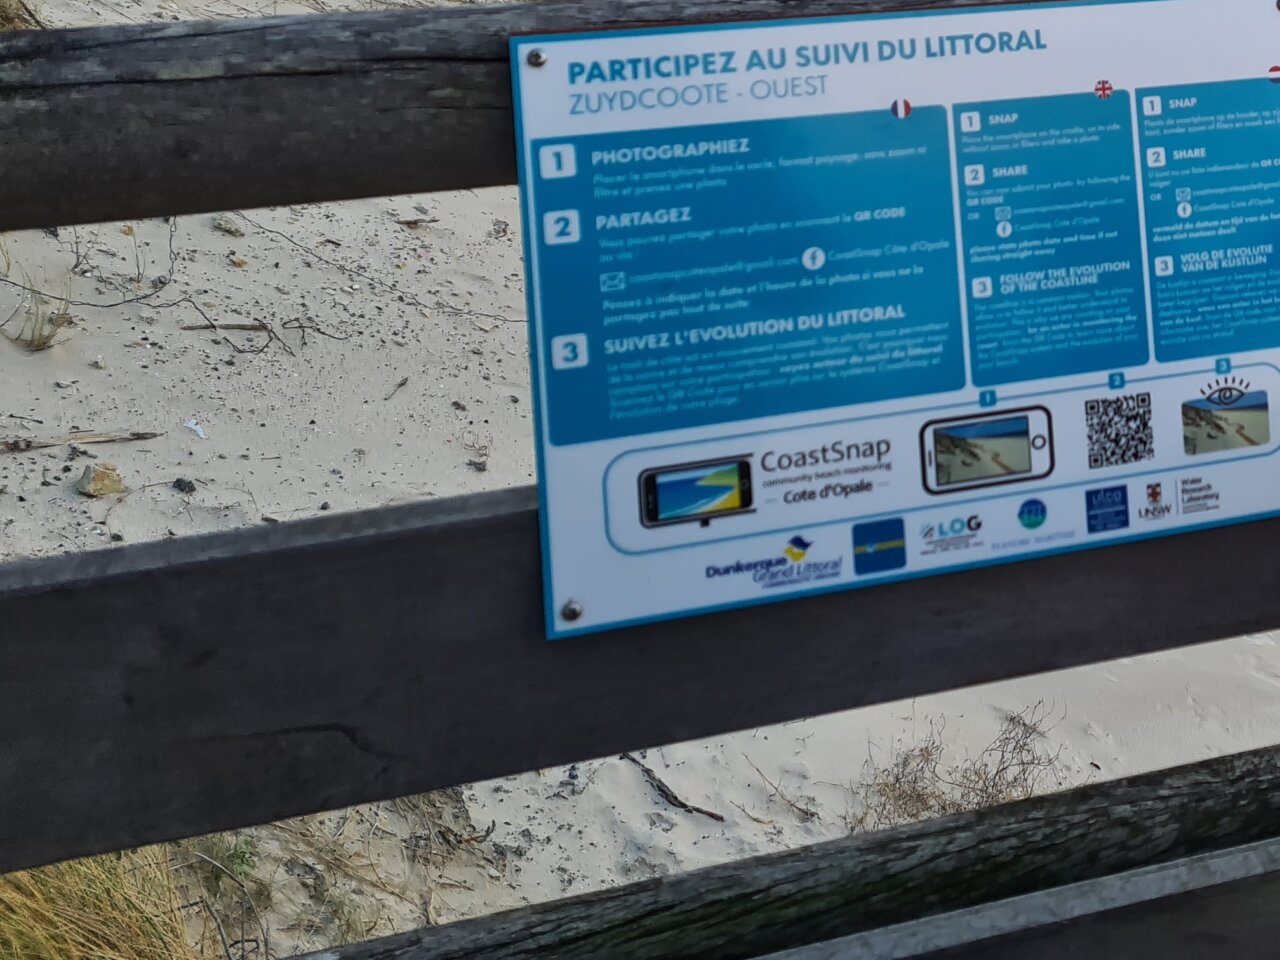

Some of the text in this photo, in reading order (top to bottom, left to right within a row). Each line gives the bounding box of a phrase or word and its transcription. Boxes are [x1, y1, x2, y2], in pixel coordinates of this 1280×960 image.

[567, 27, 1047, 85] PARTICIPEZ AU SUIVI DU LITTORAL
[568, 81, 728, 116] ZUYDCOOTE
[749, 73, 829, 100] OUEST
[1168, 97, 1196, 109] SNAP
[1149, 99, 1154, 111] 1
[967, 116, 972, 127] 1
[988, 112, 1018, 125] SNAP
[552, 151, 562, 171] 1
[591, 137, 749, 166] PHOTOGRAPHIEZ
[1152, 151, 1160, 162] 2
[1173, 147, 1206, 160] SHARE
[992, 164, 1027, 177] SHARE
[1260, 159, 1272, 167] QR
[970, 169, 979, 180] 2
[595, 206, 691, 230] PARTAGEZ
[853, 210, 871, 222] QR
[872, 206, 906, 220] CODE
[553, 216, 570, 237] 2
[1180, 243, 1273, 263] VOLG DE EVOLUTIE
[1181, 253, 1267, 273] VAN DE KUSTLIJN
[999, 259, 1130, 285] FOLLOW THE EVOLUTION
[1160, 259, 1168, 271] 3
[978, 281, 987, 293] 3
[1000, 273, 1097, 294] OF THE COASTLINE
[604, 332, 669, 355] SUIVEZ
[674, 317, 793, 346] L'EVOLUTION
[797, 313, 823, 330] DU
[827, 303, 905, 327] LITTORAL
[562, 341, 578, 362] 3
[760, 438, 891, 474] CoastSnap
[843, 461, 891, 476] monitoring
[783, 478, 872, 504] Cote d'Opale
[938, 514, 982, 537] LOG
[705, 554, 787, 579] Dunkerque
